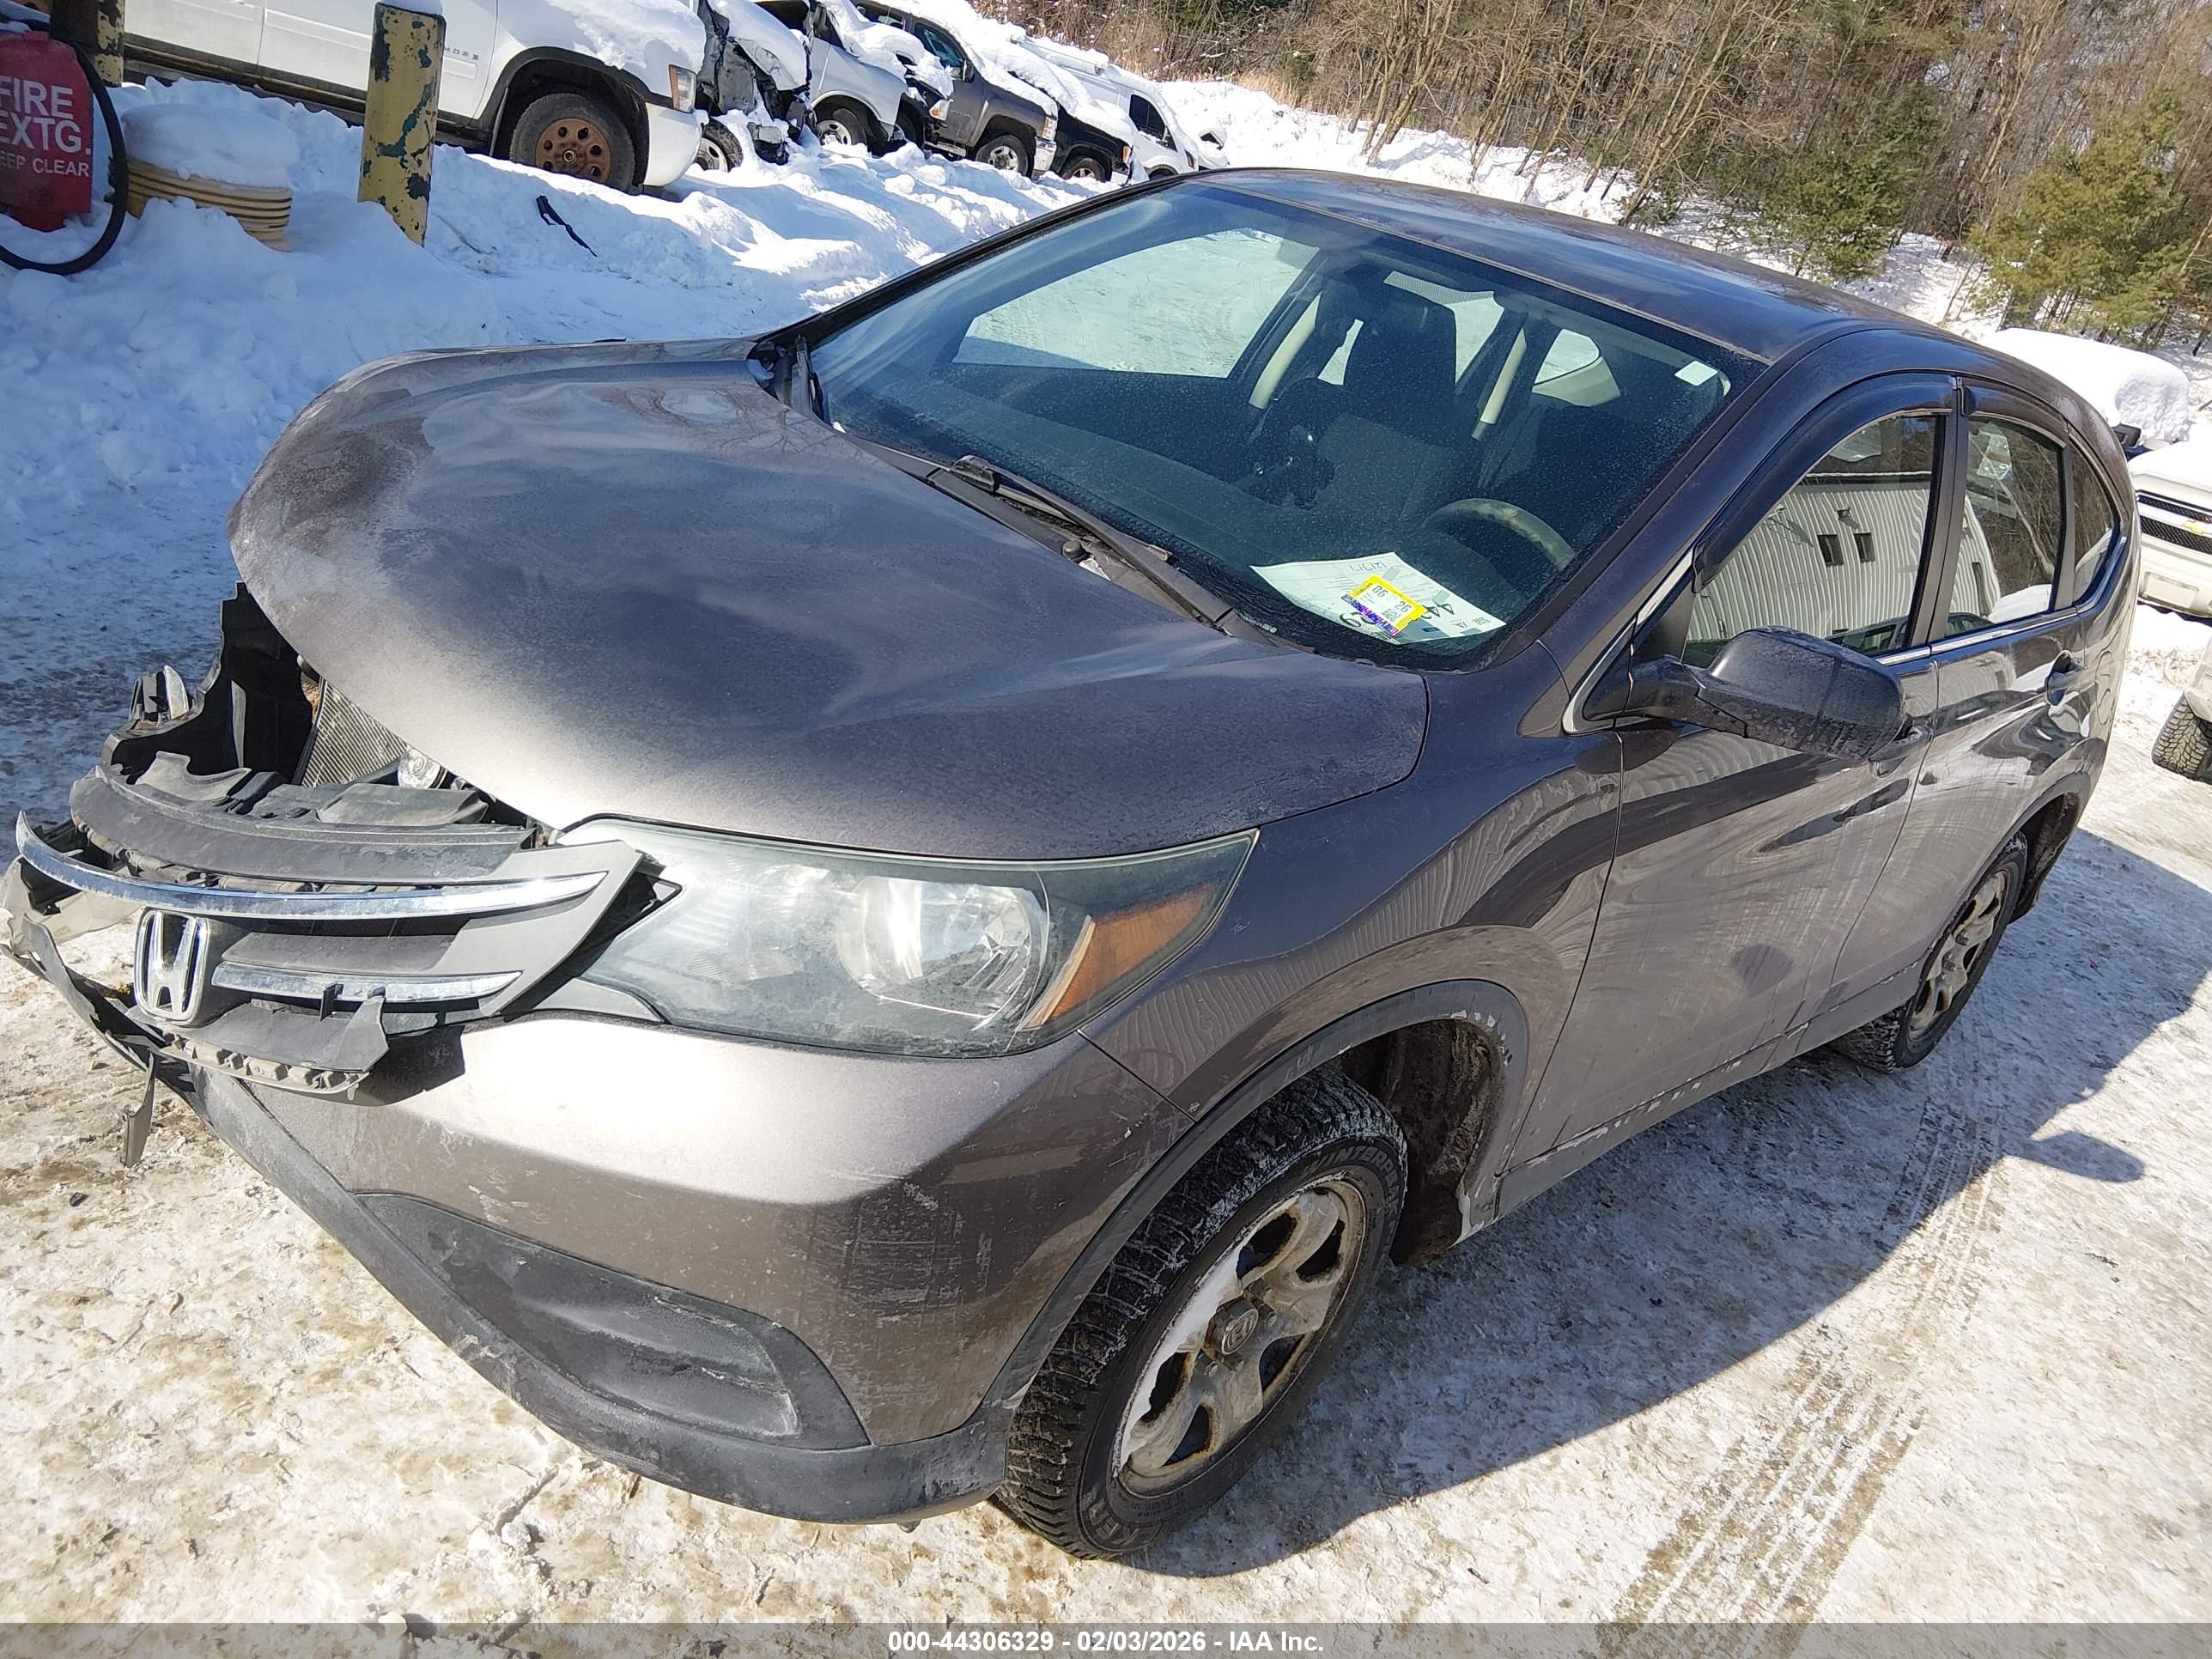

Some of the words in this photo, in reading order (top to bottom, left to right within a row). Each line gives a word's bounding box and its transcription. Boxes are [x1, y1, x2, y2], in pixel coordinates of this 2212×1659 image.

[0, 76, 74, 119] FIRE
[0, 110, 92, 155] EXTG.
[0, 150, 26, 171] EEP
[33, 157, 90, 178] CLEAR
